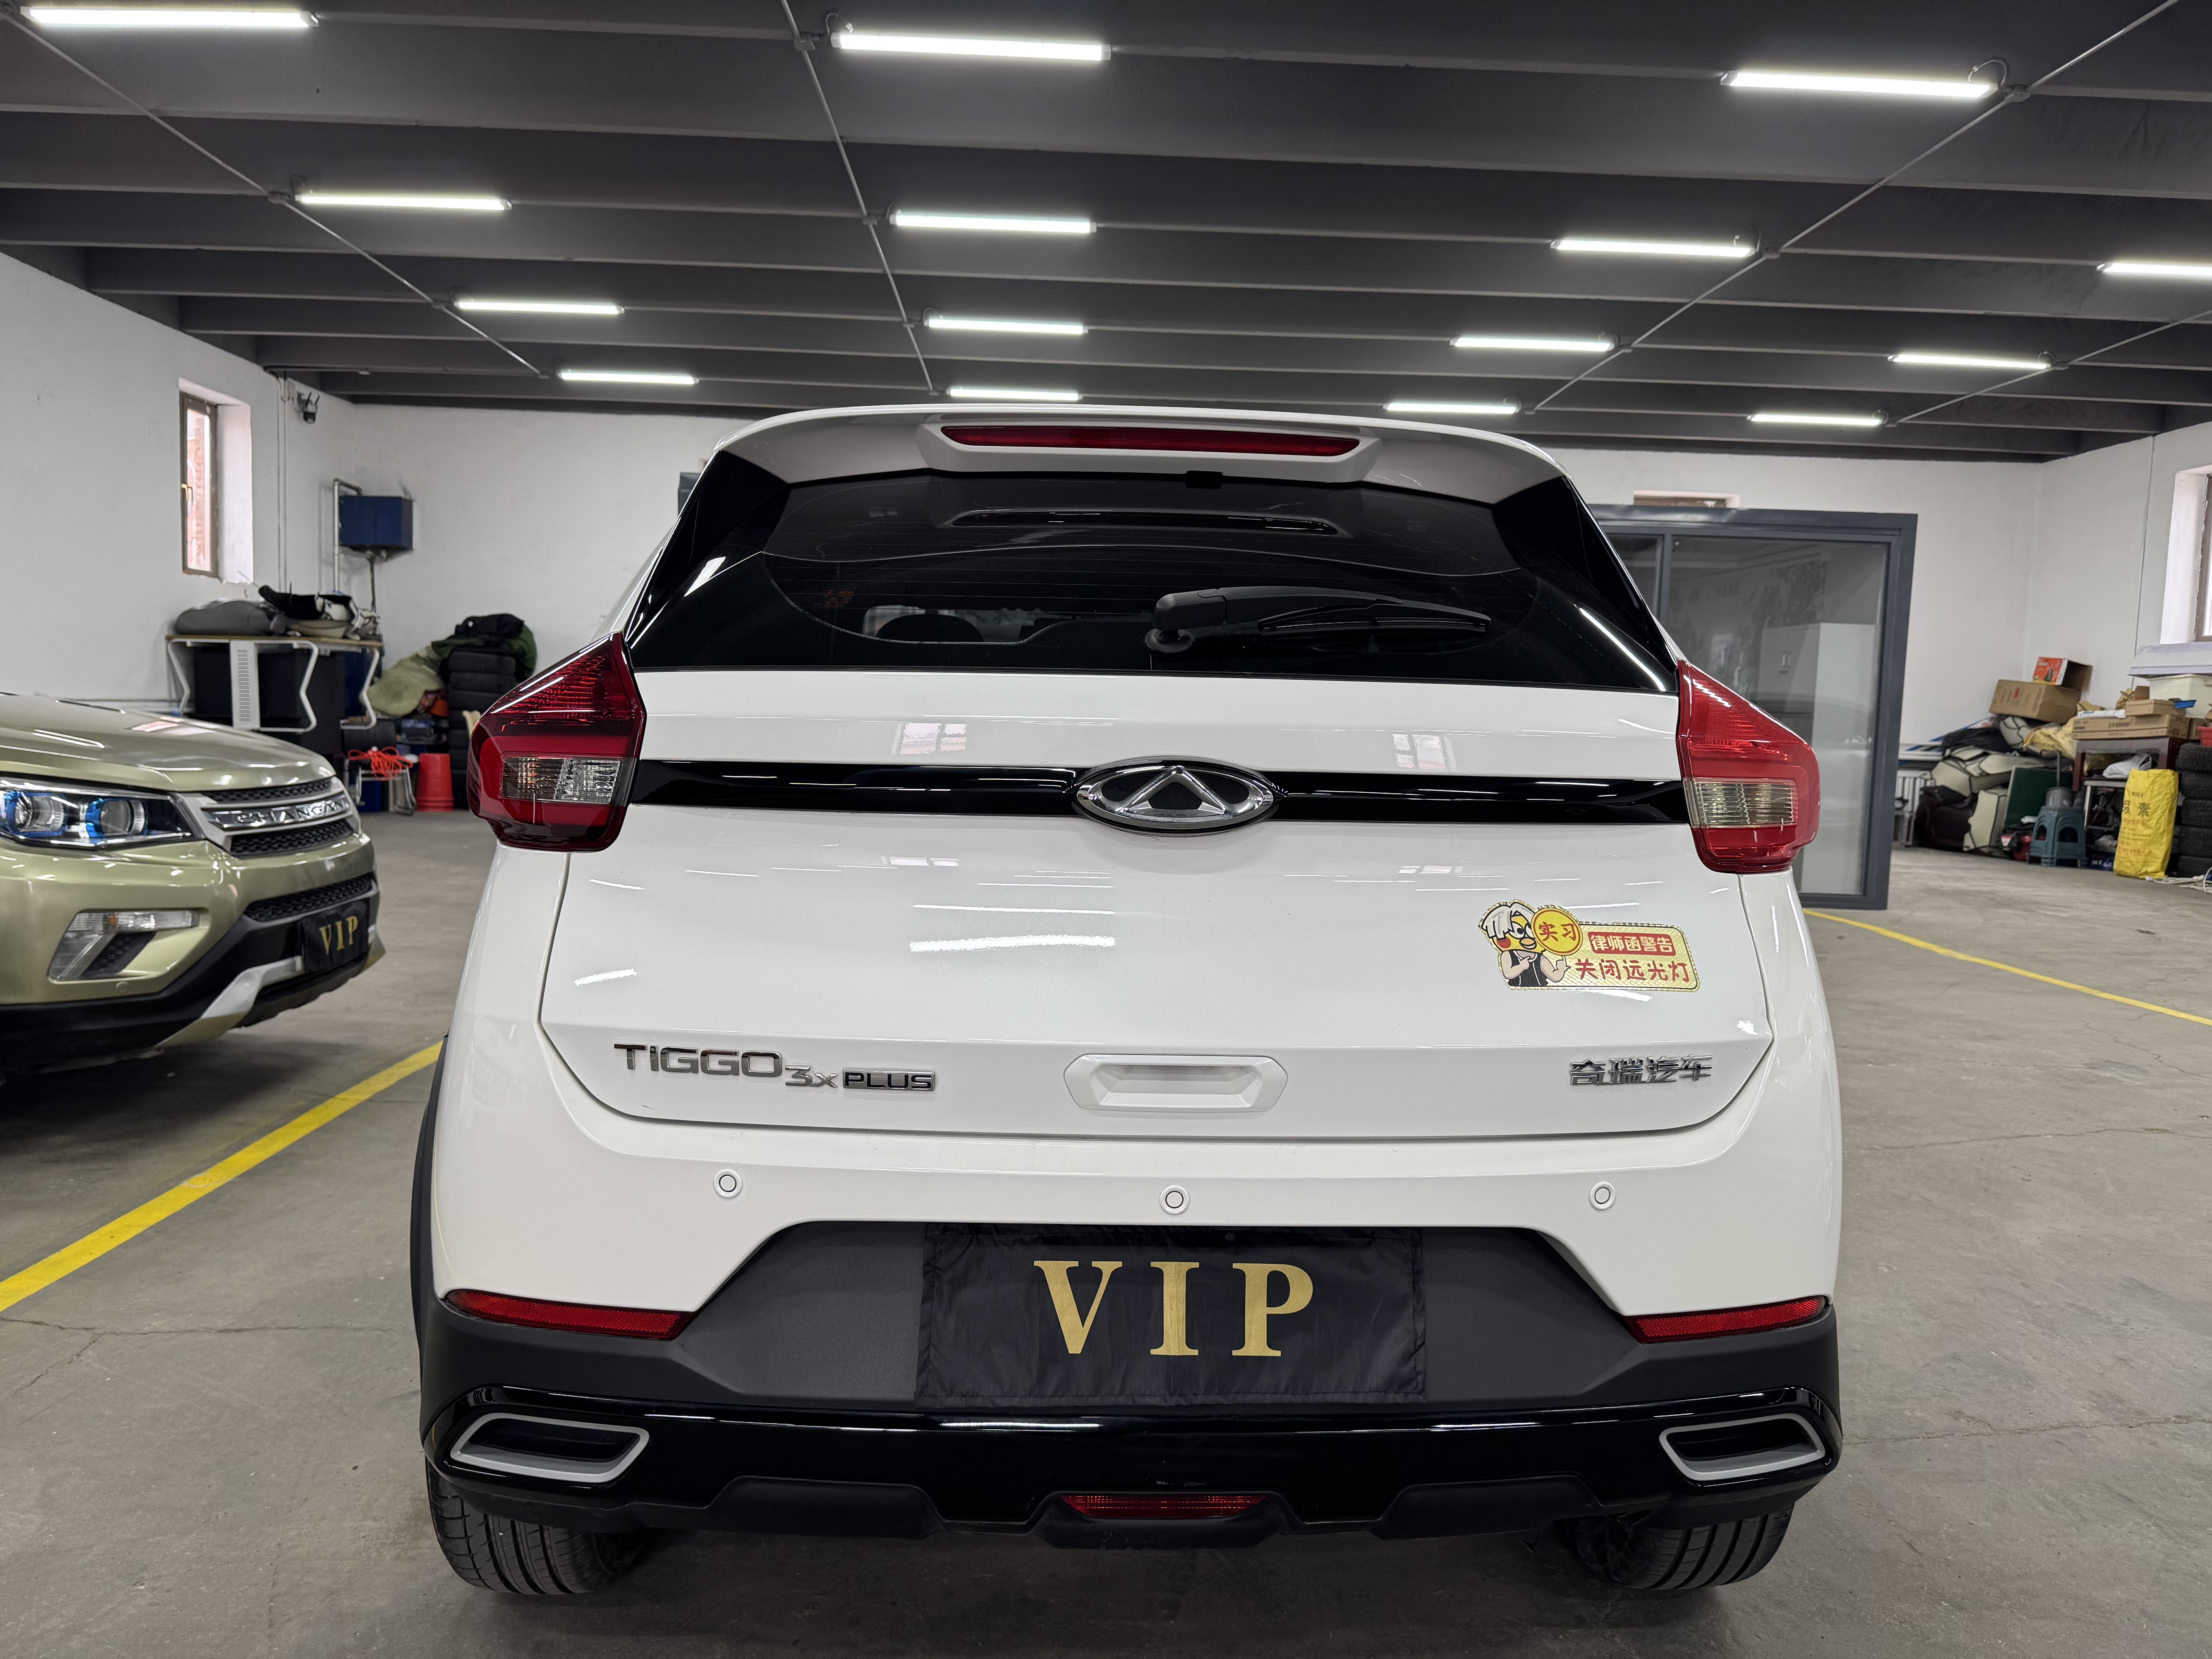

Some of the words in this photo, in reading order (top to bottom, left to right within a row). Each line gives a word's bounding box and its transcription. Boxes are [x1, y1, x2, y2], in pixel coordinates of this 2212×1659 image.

[319, 915, 358, 955] VIP
[1539, 922, 1577, 942] 实习
[1590, 934, 1674, 953] 律师函警告
[1575, 959, 1690, 983] 关闭远光灯
[845, 1071, 932, 1090] PLUS
[1569, 1054, 1713, 1085] 奇瑞汽车
[1034, 1260, 1313, 1357] VIP
